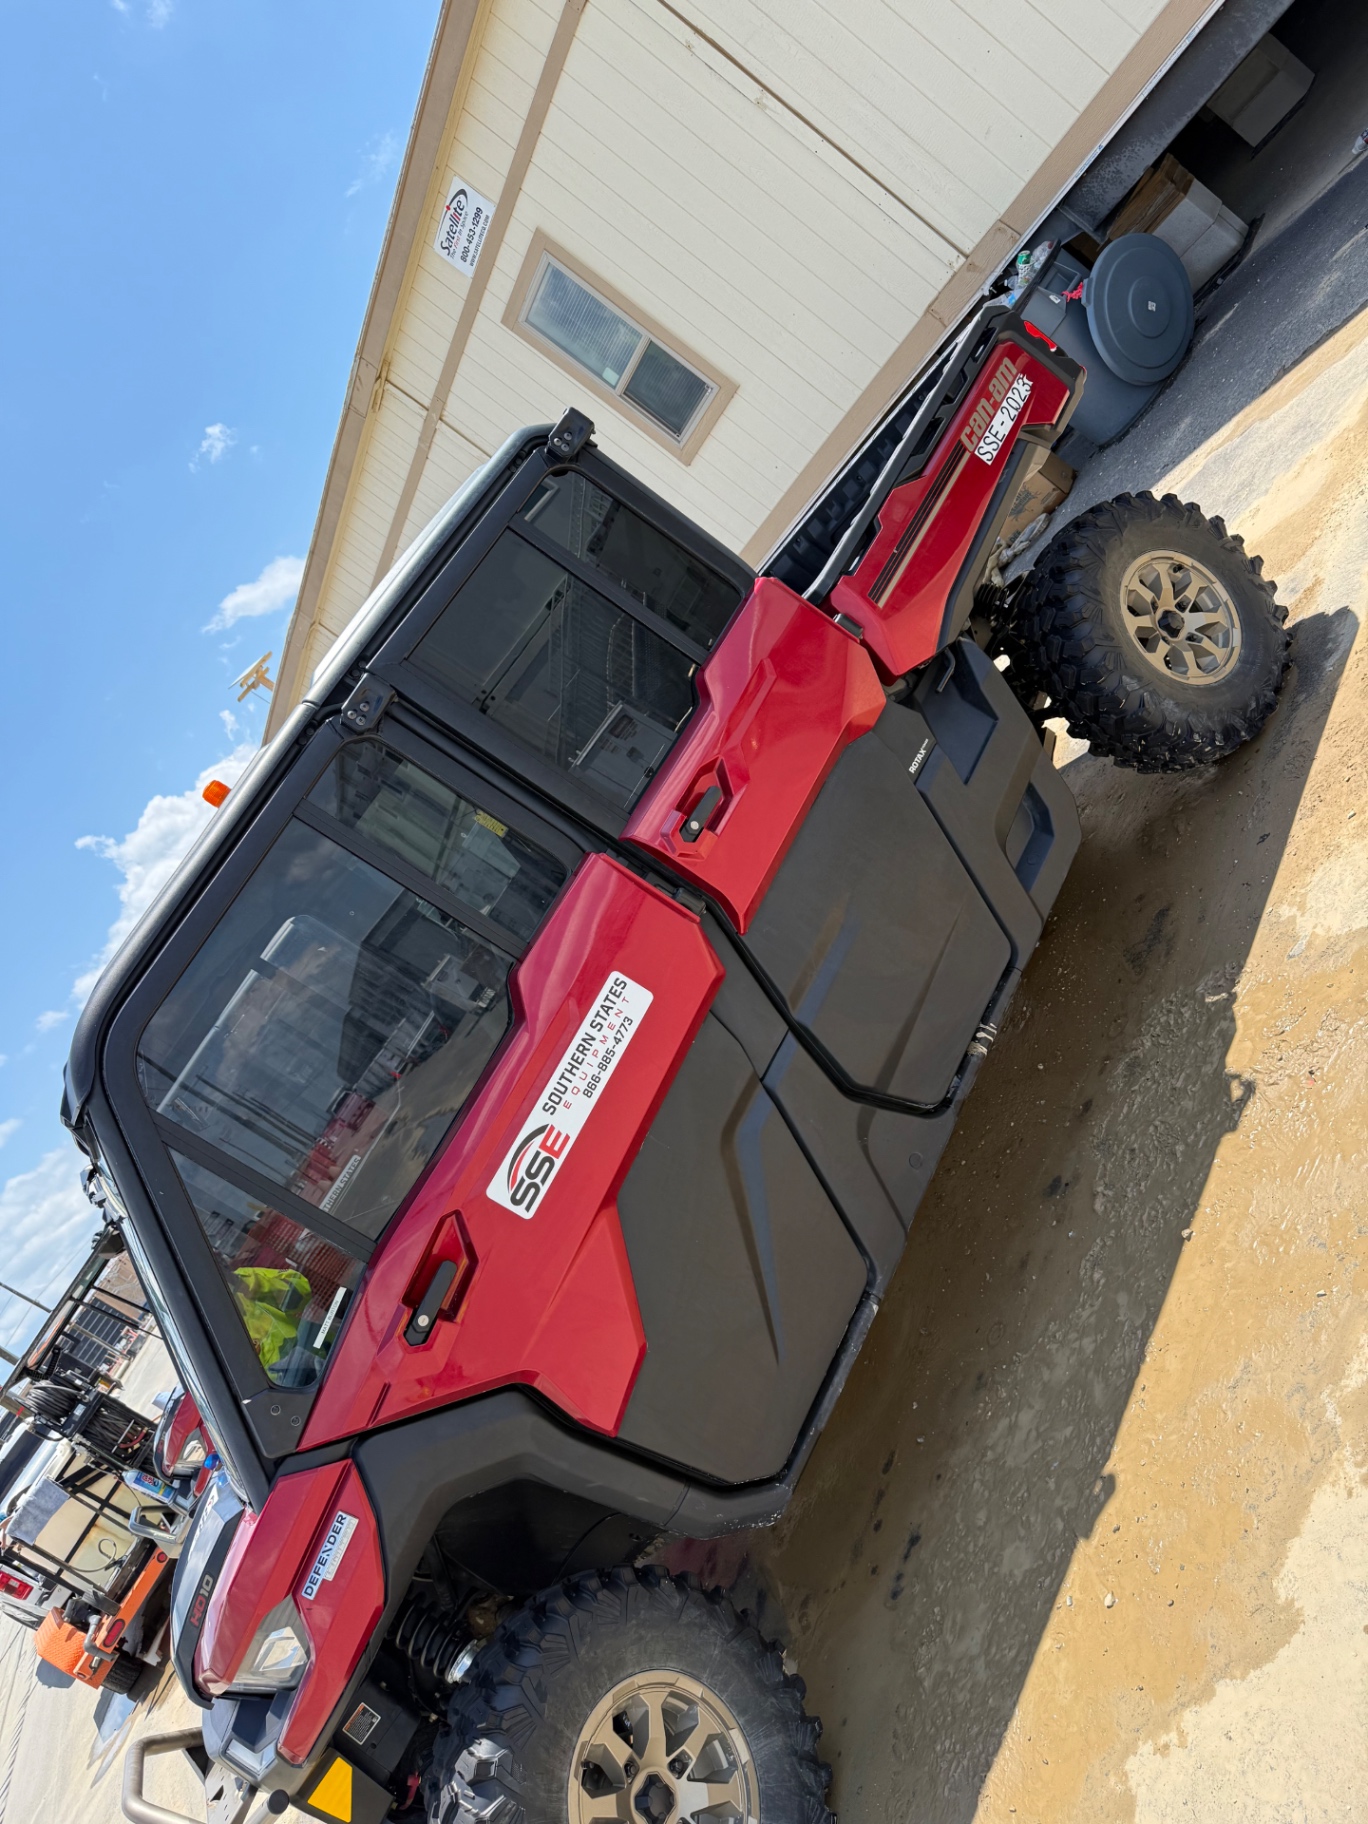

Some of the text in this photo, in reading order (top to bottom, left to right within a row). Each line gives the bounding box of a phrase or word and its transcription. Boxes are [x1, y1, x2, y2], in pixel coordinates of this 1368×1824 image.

[440, 199, 465, 256] Satellite
[460, 206, 484, 262] 800-453-1299
[960, 356, 1018, 453] can-am
[908, 746, 927, 774] ROTAX
[542, 977, 627, 1116] SOUTHERN STATES
[563, 996, 630, 1110] EQUIPMENT
[582, 1016, 634, 1098] 866-885-4773
[510, 1124, 571, 1213] SSE
[303, 1514, 347, 1596] DEFENDER
[190, 1574, 214, 1627] HD10
